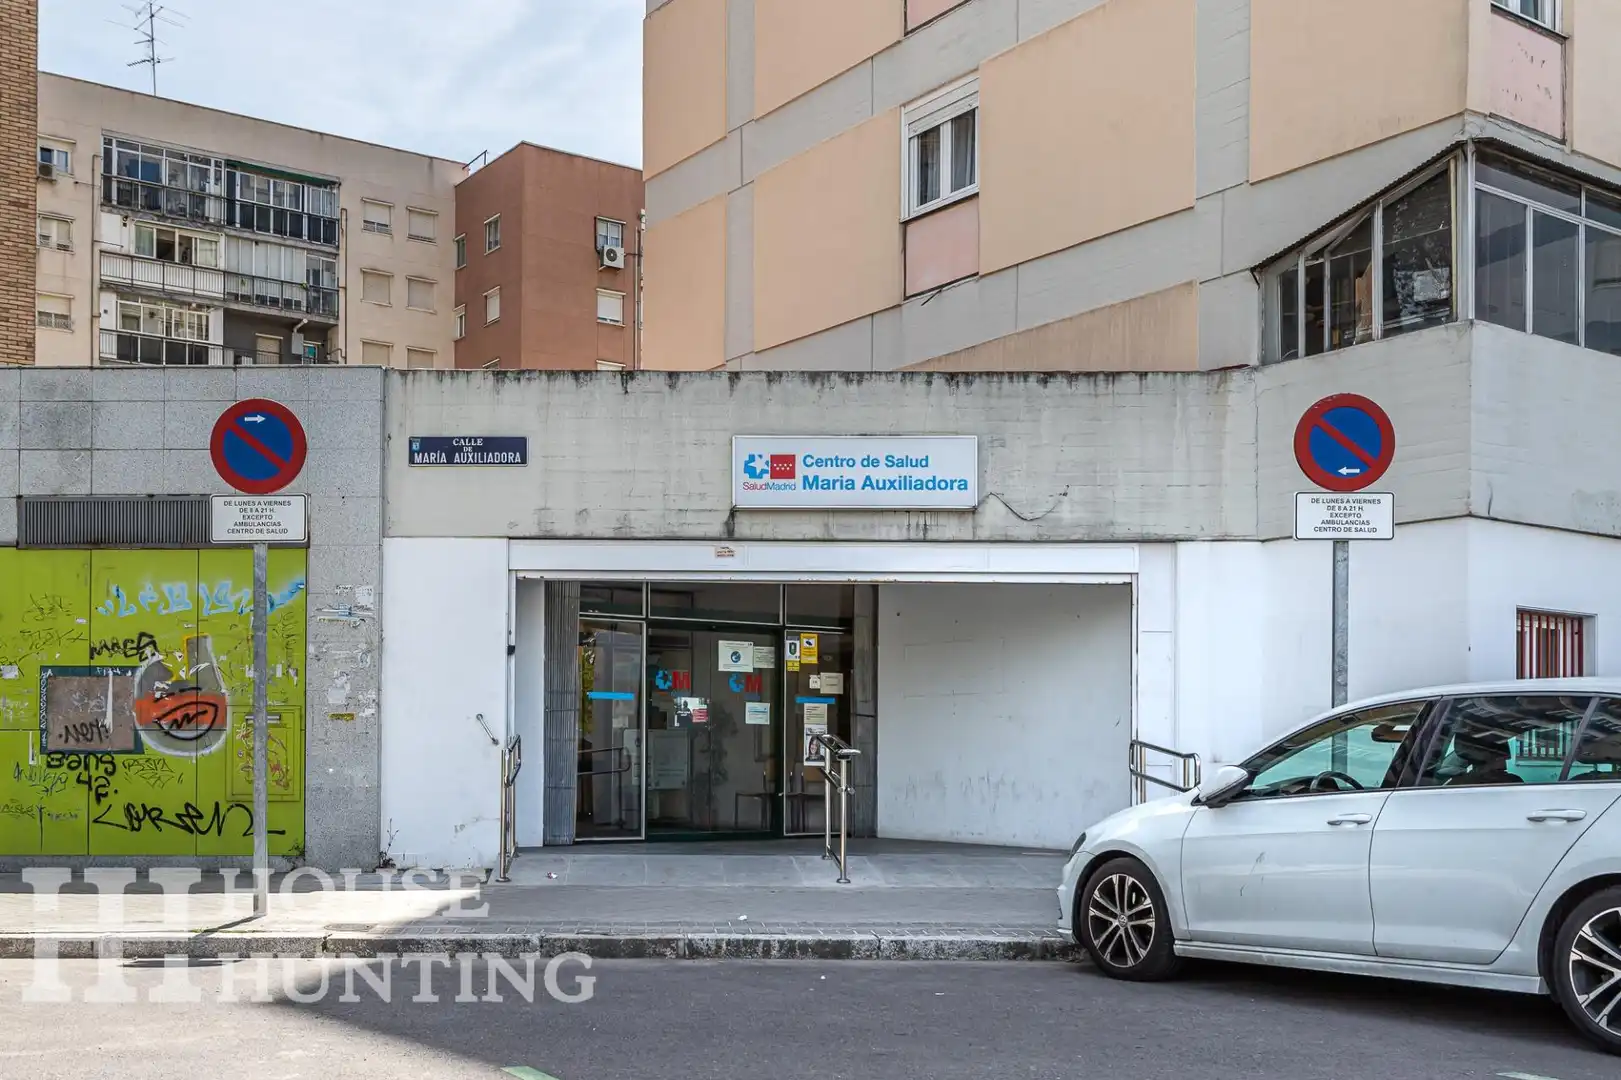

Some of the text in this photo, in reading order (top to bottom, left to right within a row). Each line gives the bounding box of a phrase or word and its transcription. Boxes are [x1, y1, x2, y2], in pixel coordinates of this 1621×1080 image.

[452, 438, 483, 446] CALLE
[414, 450, 521, 464] MARÍA AUXILIADORA
[802, 454, 929, 468] Centro de Salud
[802, 474, 969, 491] Maria Auxiliadora
